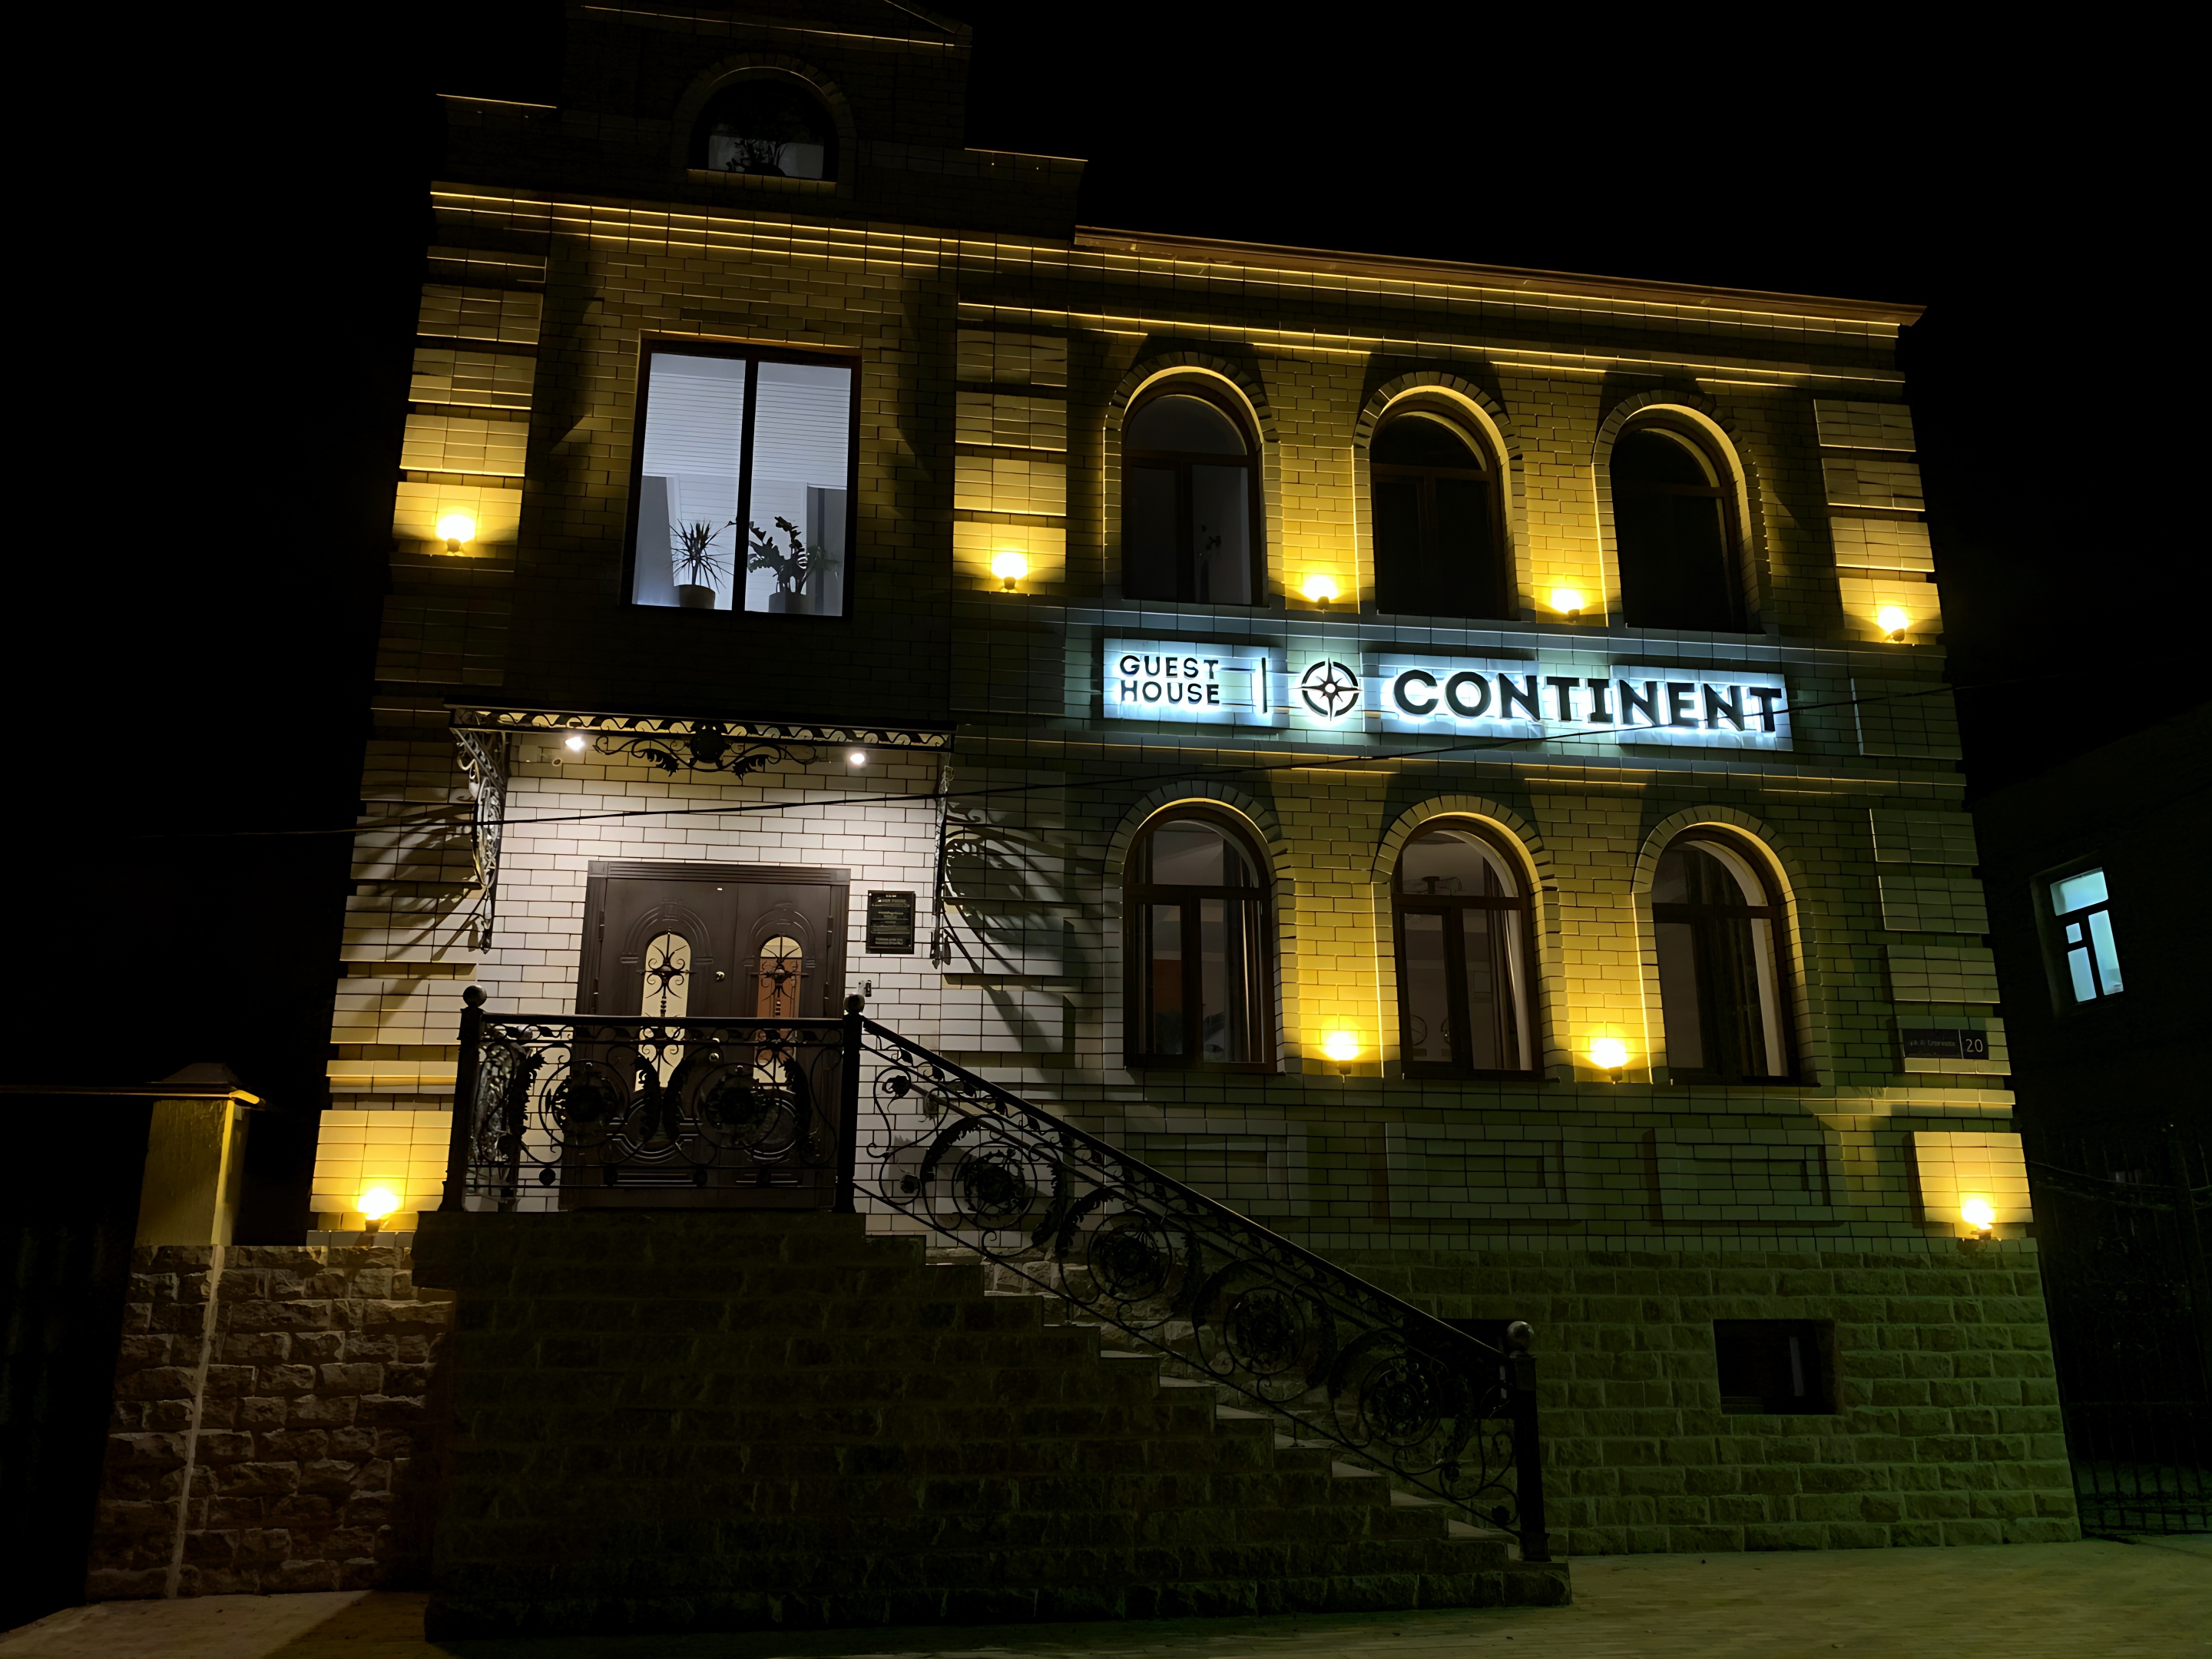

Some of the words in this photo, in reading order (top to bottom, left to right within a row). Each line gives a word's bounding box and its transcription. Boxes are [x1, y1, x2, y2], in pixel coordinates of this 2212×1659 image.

[1120, 654, 1220, 680] GUEST
[1121, 680, 1220, 705] HOUSE
[1394, 670, 1782, 732] CONTINENT
[1965, 1038, 1983, 1052] 20
